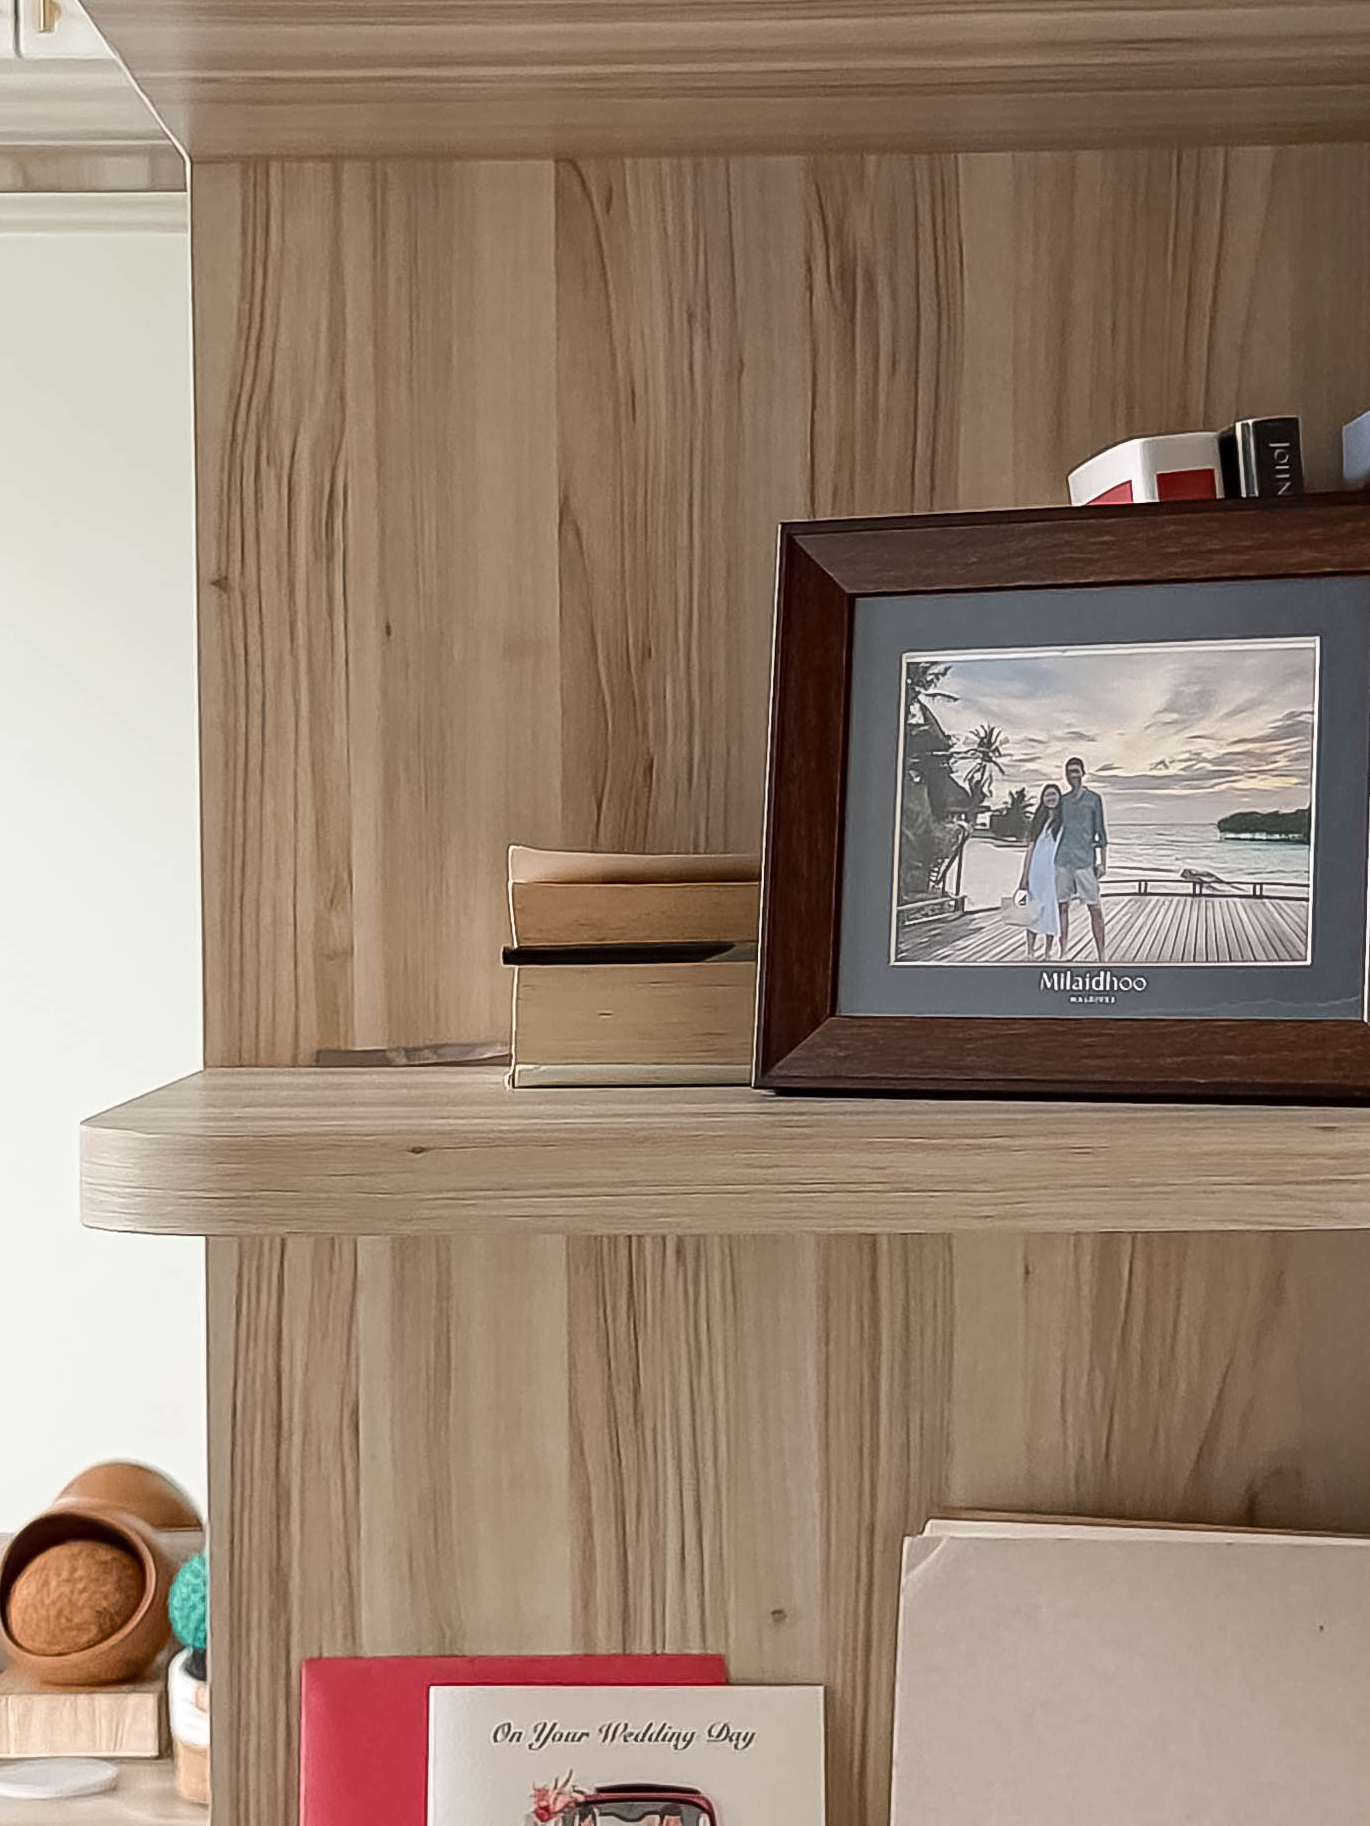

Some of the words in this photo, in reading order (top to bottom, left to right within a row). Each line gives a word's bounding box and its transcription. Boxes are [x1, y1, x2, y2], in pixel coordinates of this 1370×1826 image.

[1040, 971, 1147, 991] Milaidhoo
[493, 1722, 523, 1744] On
[528, 1722, 590, 1751] Your
[599, 1722, 697, 1751] Wedding
[707, 1722, 756, 1751] Day
